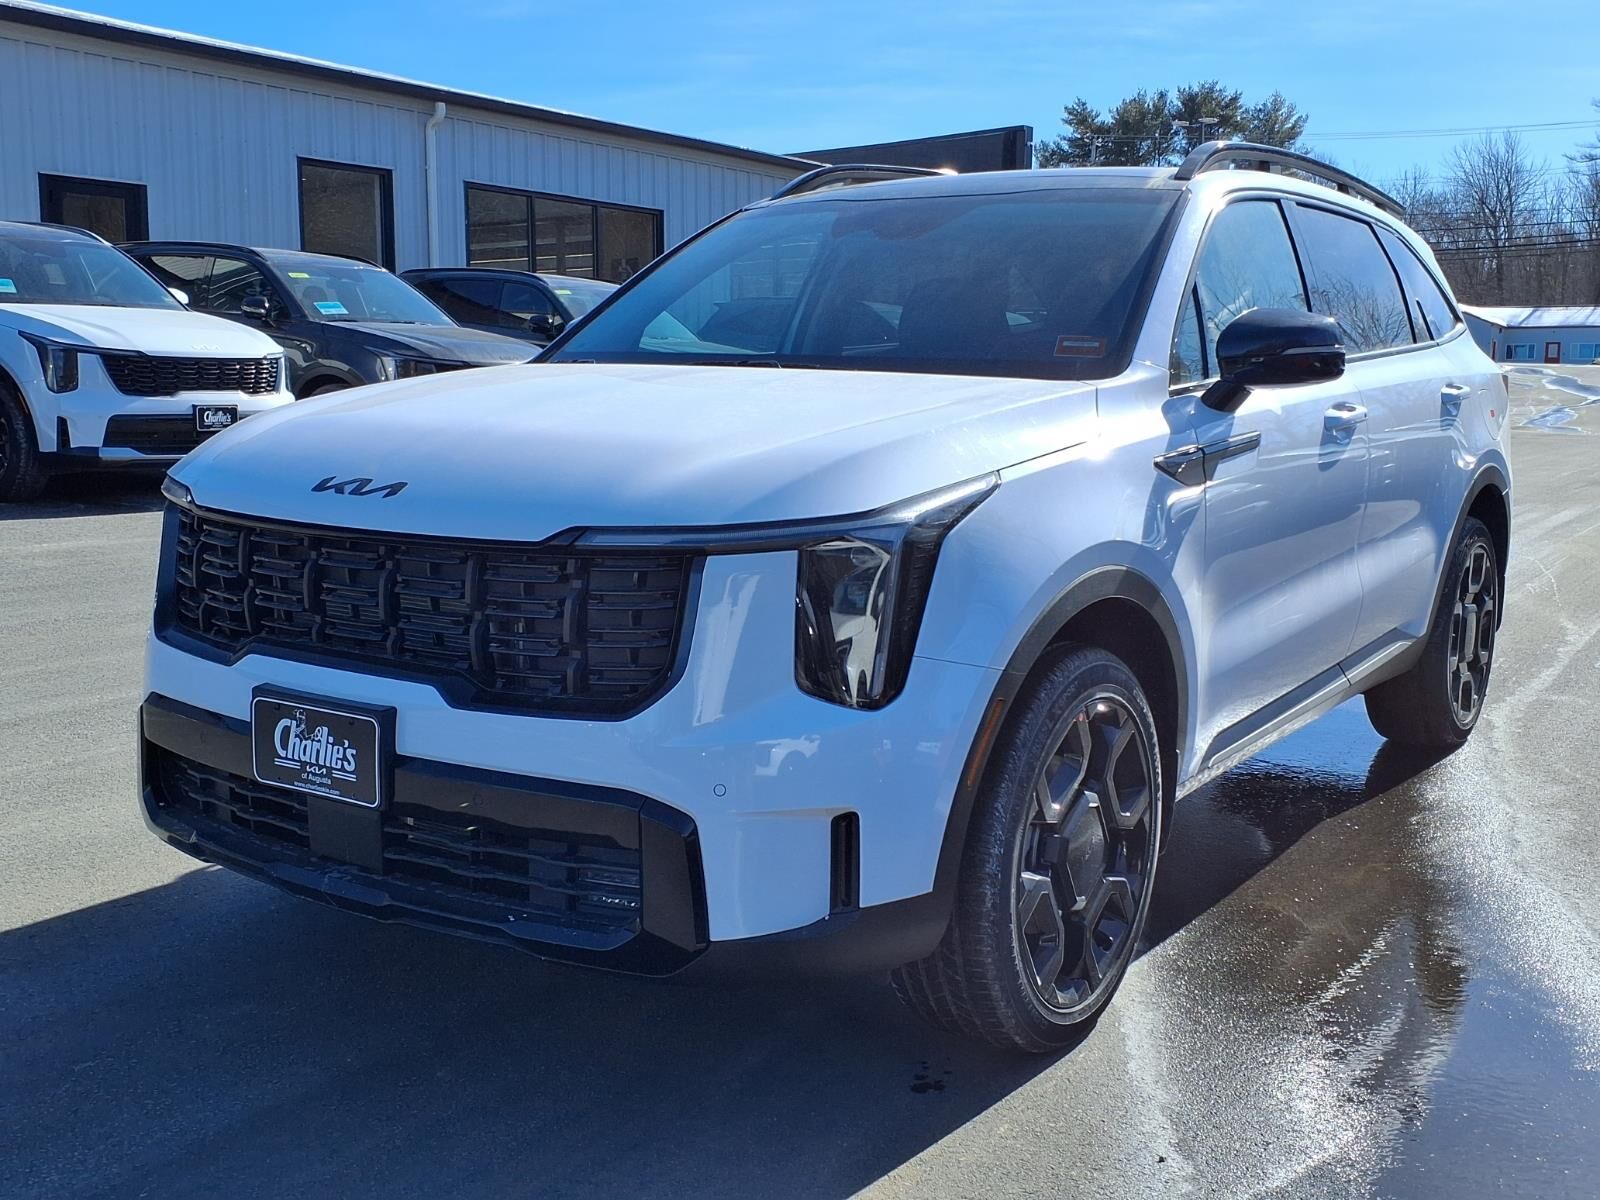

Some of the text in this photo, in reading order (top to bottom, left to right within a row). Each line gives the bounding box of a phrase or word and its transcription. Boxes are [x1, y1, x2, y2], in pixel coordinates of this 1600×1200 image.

[310, 475, 409, 499] KIA
[274, 718, 357, 772] Charlie's
[306, 764, 327, 775] KIA
[308, 773, 332, 785] Augusta
